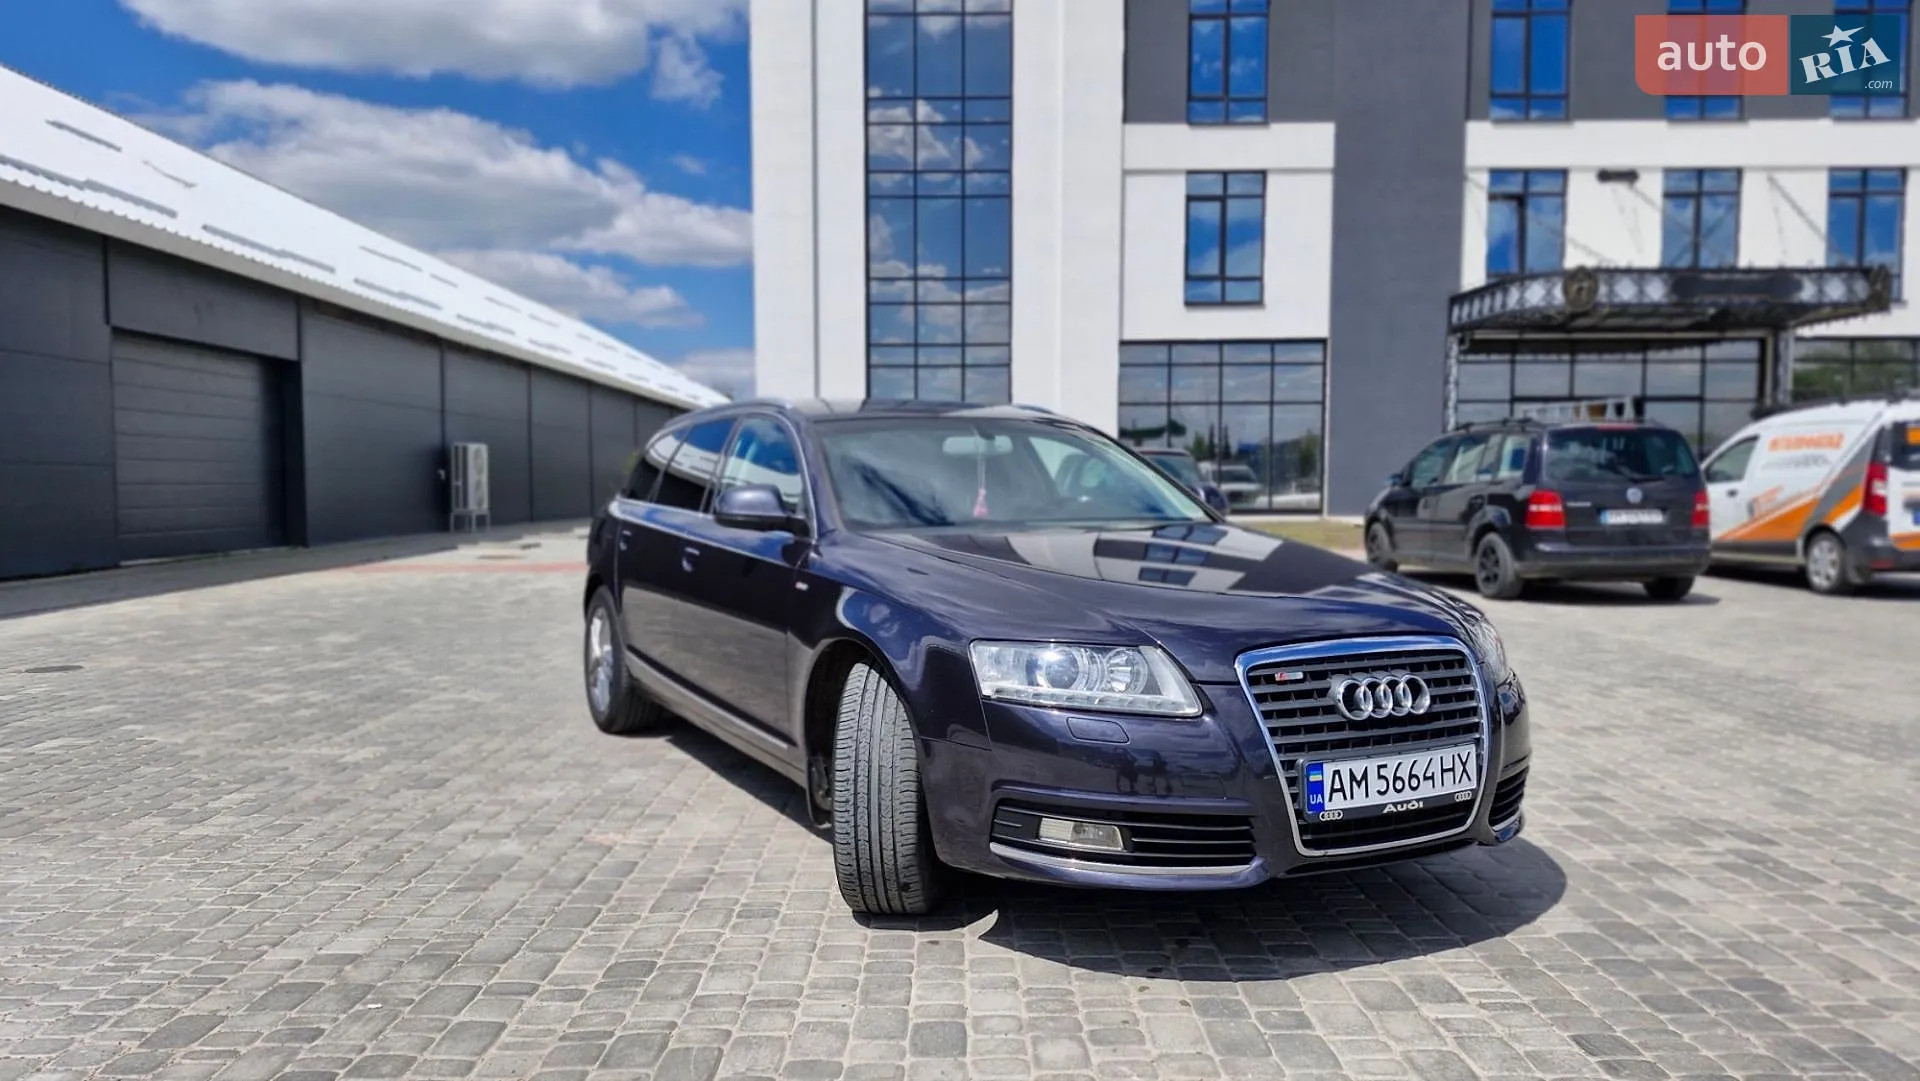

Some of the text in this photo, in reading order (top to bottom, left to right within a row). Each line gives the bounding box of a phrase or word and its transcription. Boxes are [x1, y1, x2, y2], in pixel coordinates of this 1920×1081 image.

[1328, 751, 1472, 803] AM 5664 HX
[1309, 793, 1323, 805] UA
